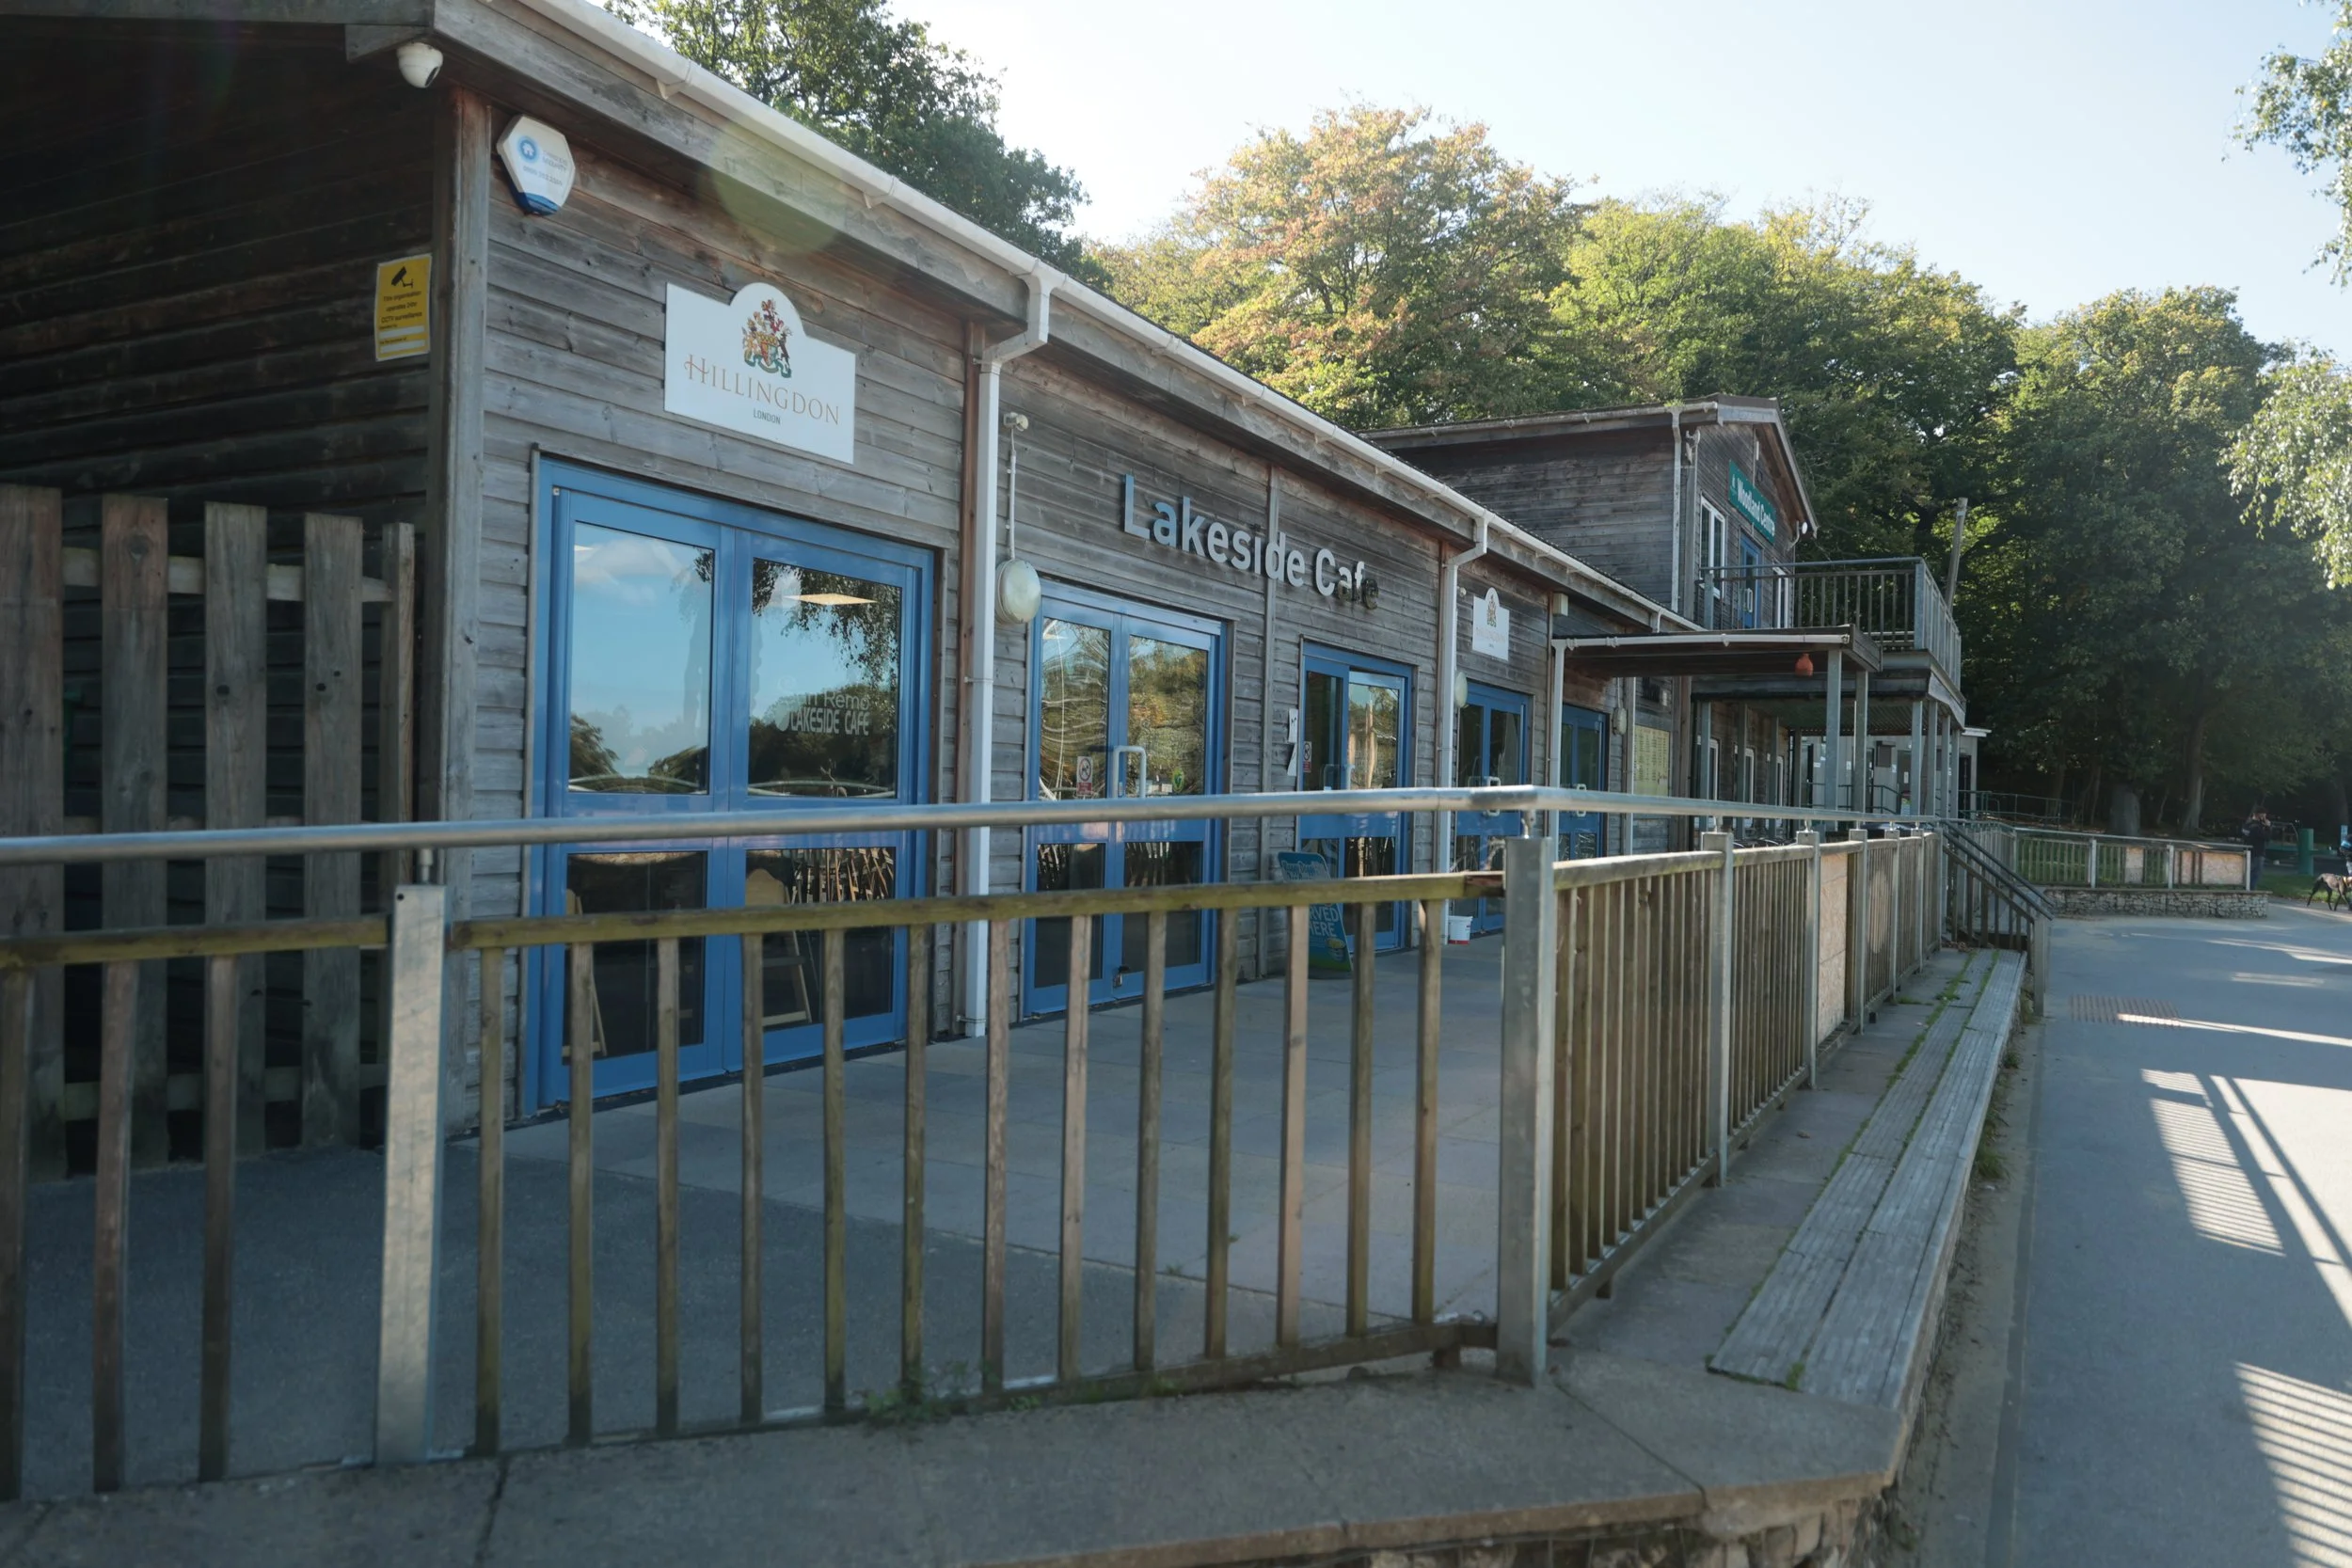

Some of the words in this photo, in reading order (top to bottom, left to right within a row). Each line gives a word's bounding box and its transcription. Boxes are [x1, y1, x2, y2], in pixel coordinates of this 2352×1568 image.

[684, 354, 839, 425] HILLINGDON
[753, 408, 781, 425] LONDON
[1123, 473, 1306, 588] Lakeside
[1314, 547, 1380, 611] Cafe
[824, 691, 870, 709] Remo
[790, 707, 840, 734] LAKESIDE
[844, 711, 870, 736] CAFE
[1309, 906, 1339, 922] RVED
